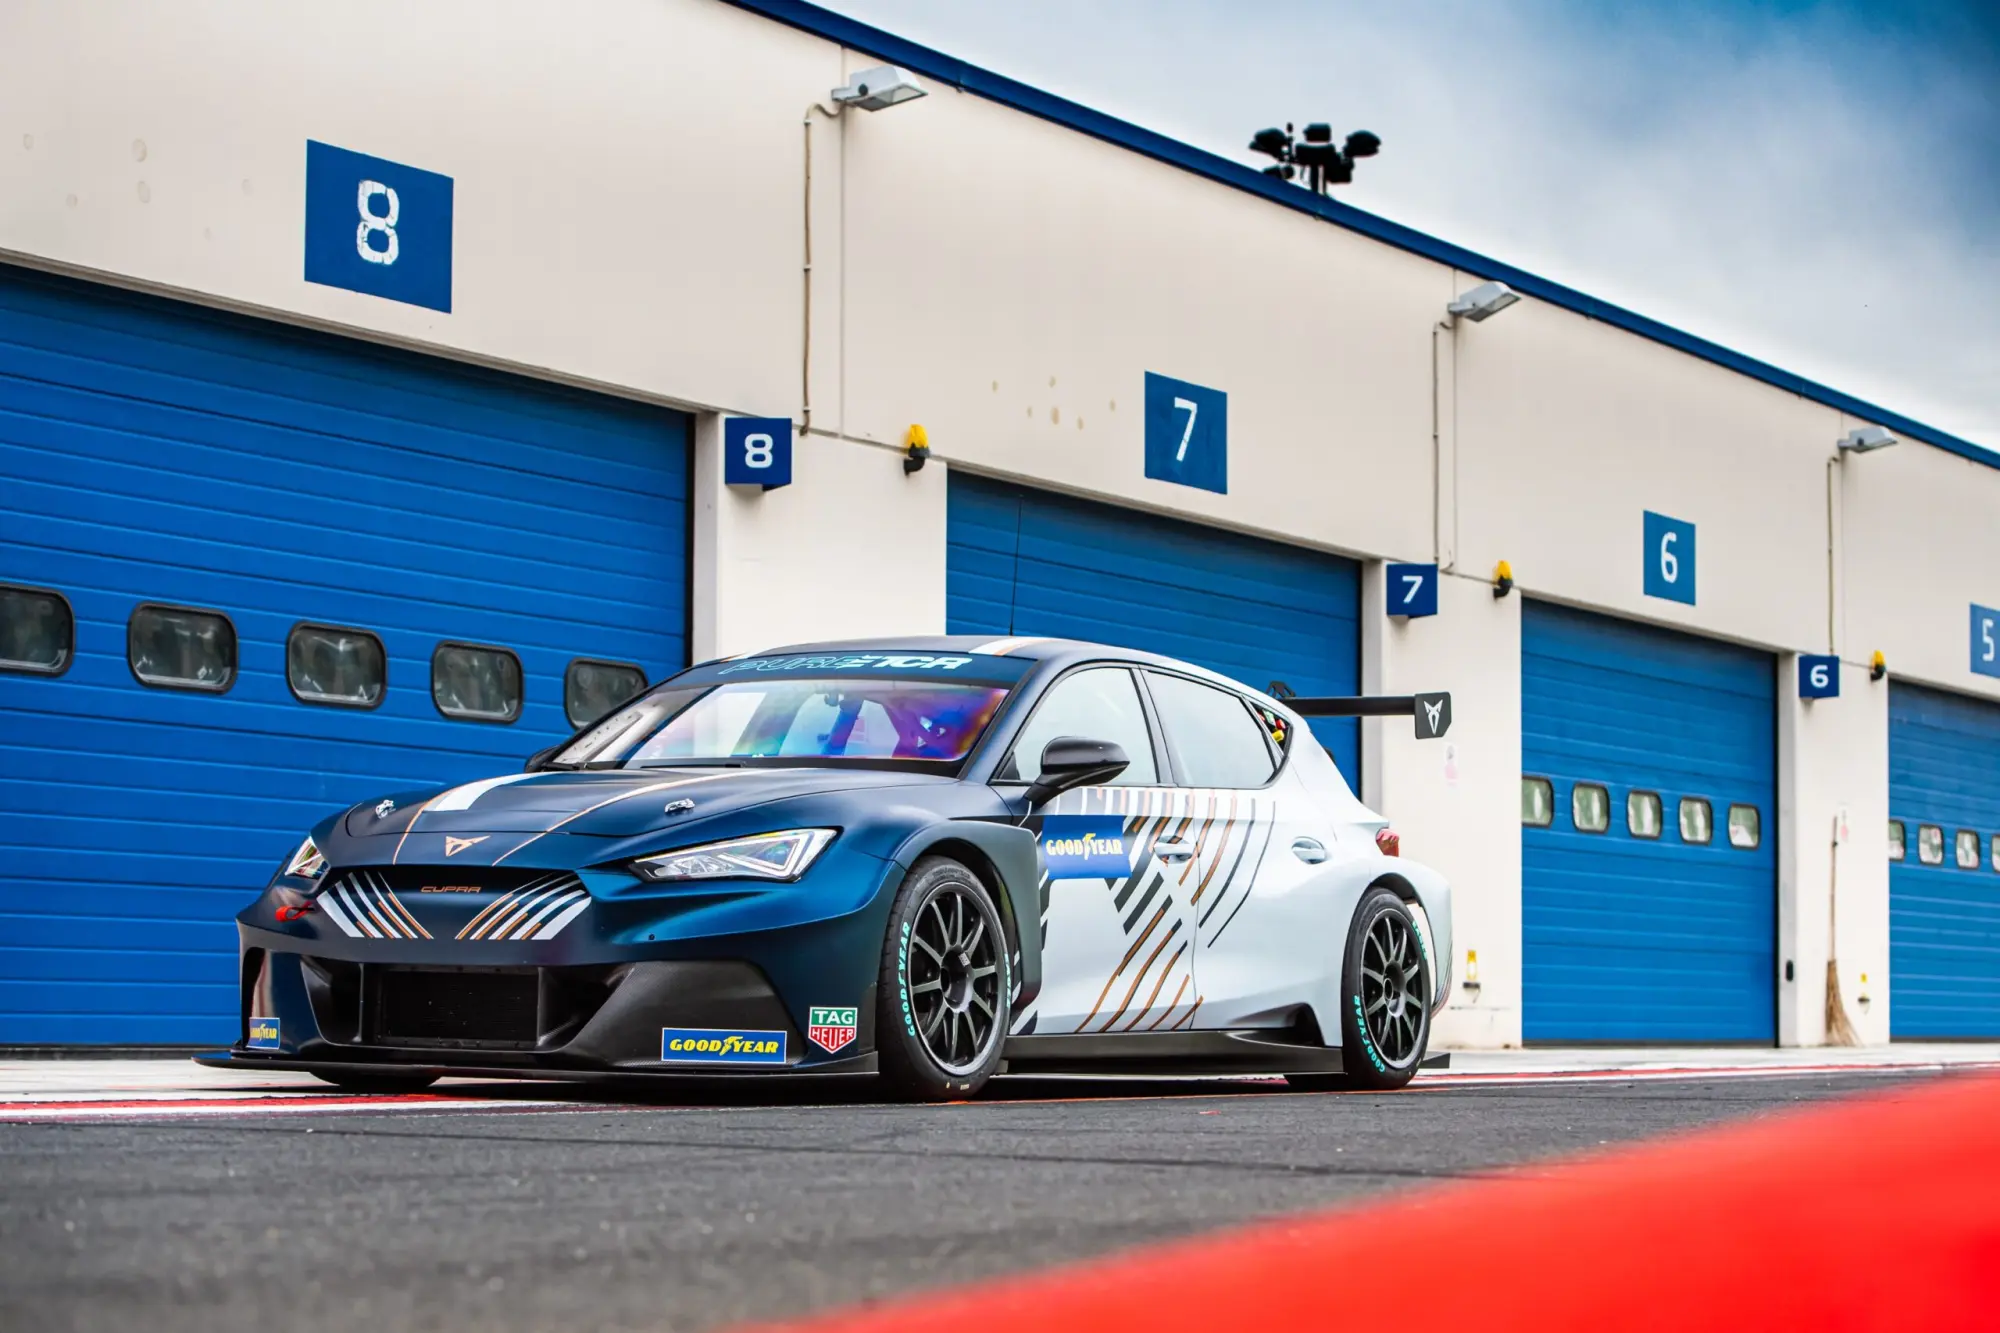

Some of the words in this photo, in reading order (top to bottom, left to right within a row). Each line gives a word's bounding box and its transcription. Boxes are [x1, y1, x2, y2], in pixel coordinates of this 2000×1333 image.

[357, 180, 400, 265] 8
[1174, 397, 1198, 462] 7
[744, 433, 773, 468] 8
[1661, 532, 1678, 583] 6
[1402, 575, 1423, 603] 7
[1982, 618, 1995, 662] 5
[1810, 665, 1829, 687] 6
[1046, 833, 1123, 860] GOODYEAR
[898, 921, 916, 1037] GOODYEAR
[814, 1010, 854, 1025] TAG
[1354, 995, 1386, 1073] GOODYEAR
[669, 1035, 779, 1056] GOODYEAR
[812, 1028, 854, 1050] HEUER
